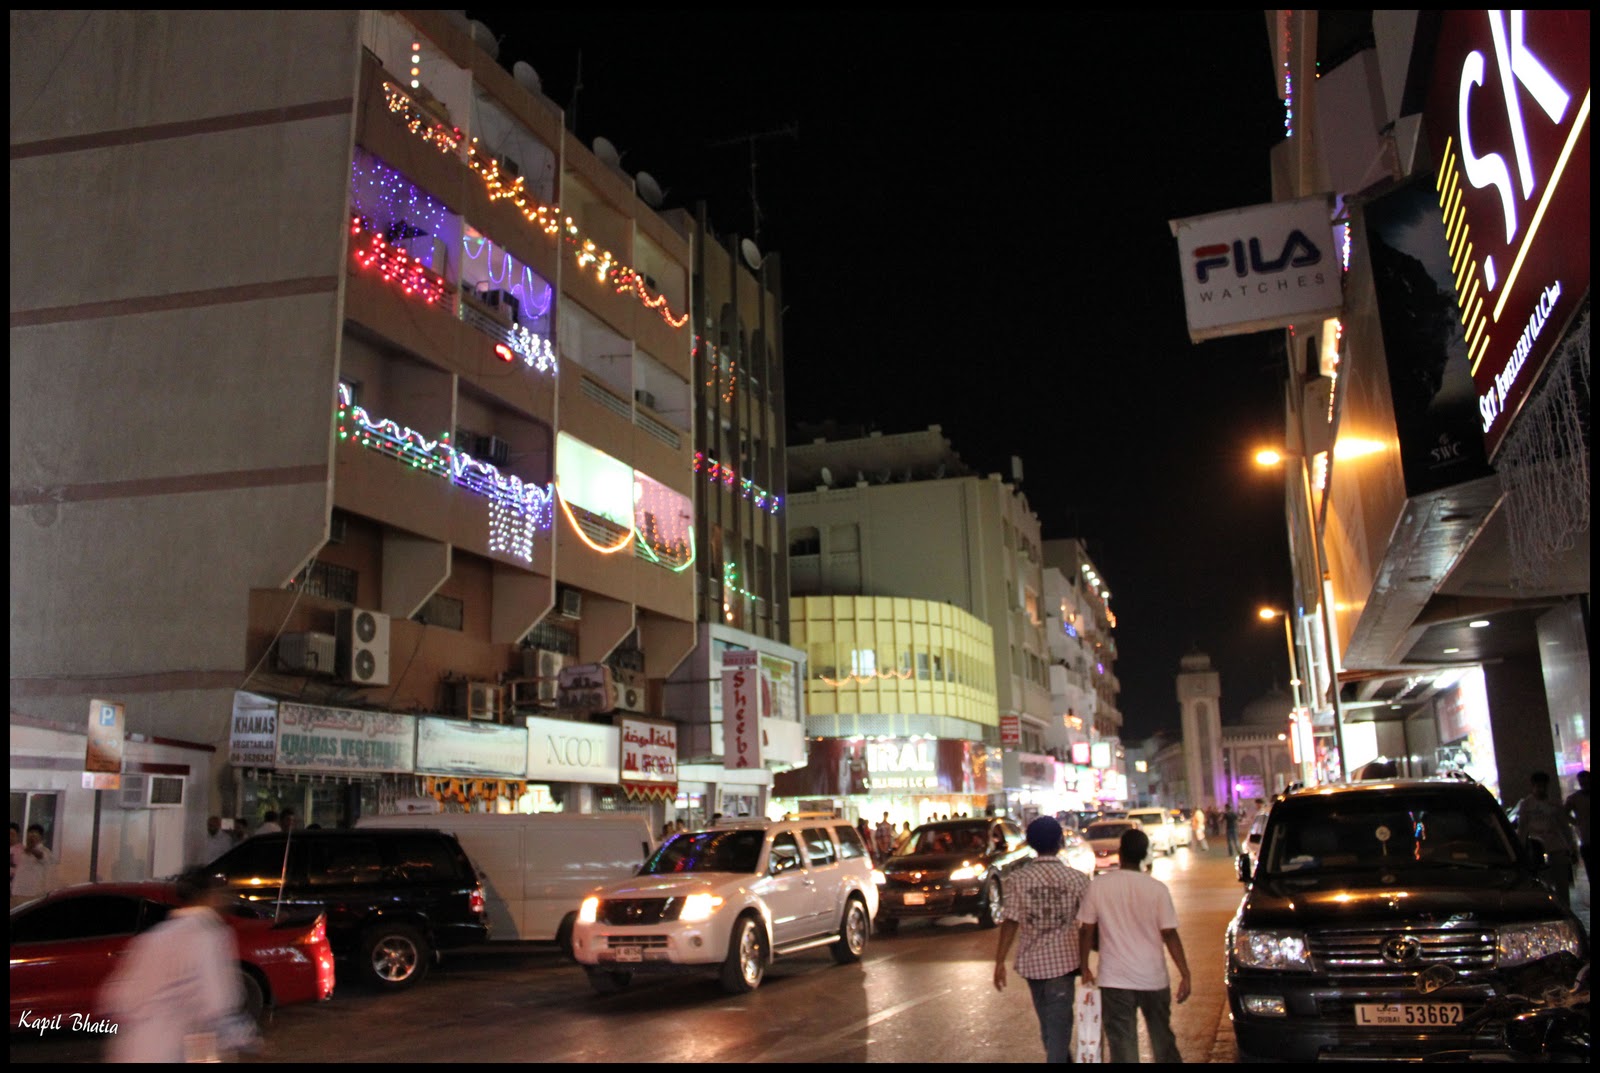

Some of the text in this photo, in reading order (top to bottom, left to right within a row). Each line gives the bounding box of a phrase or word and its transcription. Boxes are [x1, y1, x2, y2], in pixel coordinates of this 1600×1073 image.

[1193, 229, 1322, 284] FILA
[1200, 272, 1325, 302] WATCHES
[101, 707, 114, 726] P
[234, 716, 275, 734] KHAMAS
[733, 671, 748, 769] Sheeba
[281, 733, 338, 756] KHAMAS
[1361, 1007, 1371, 1023] L
[1405, 1006, 1460, 1024] 53662
